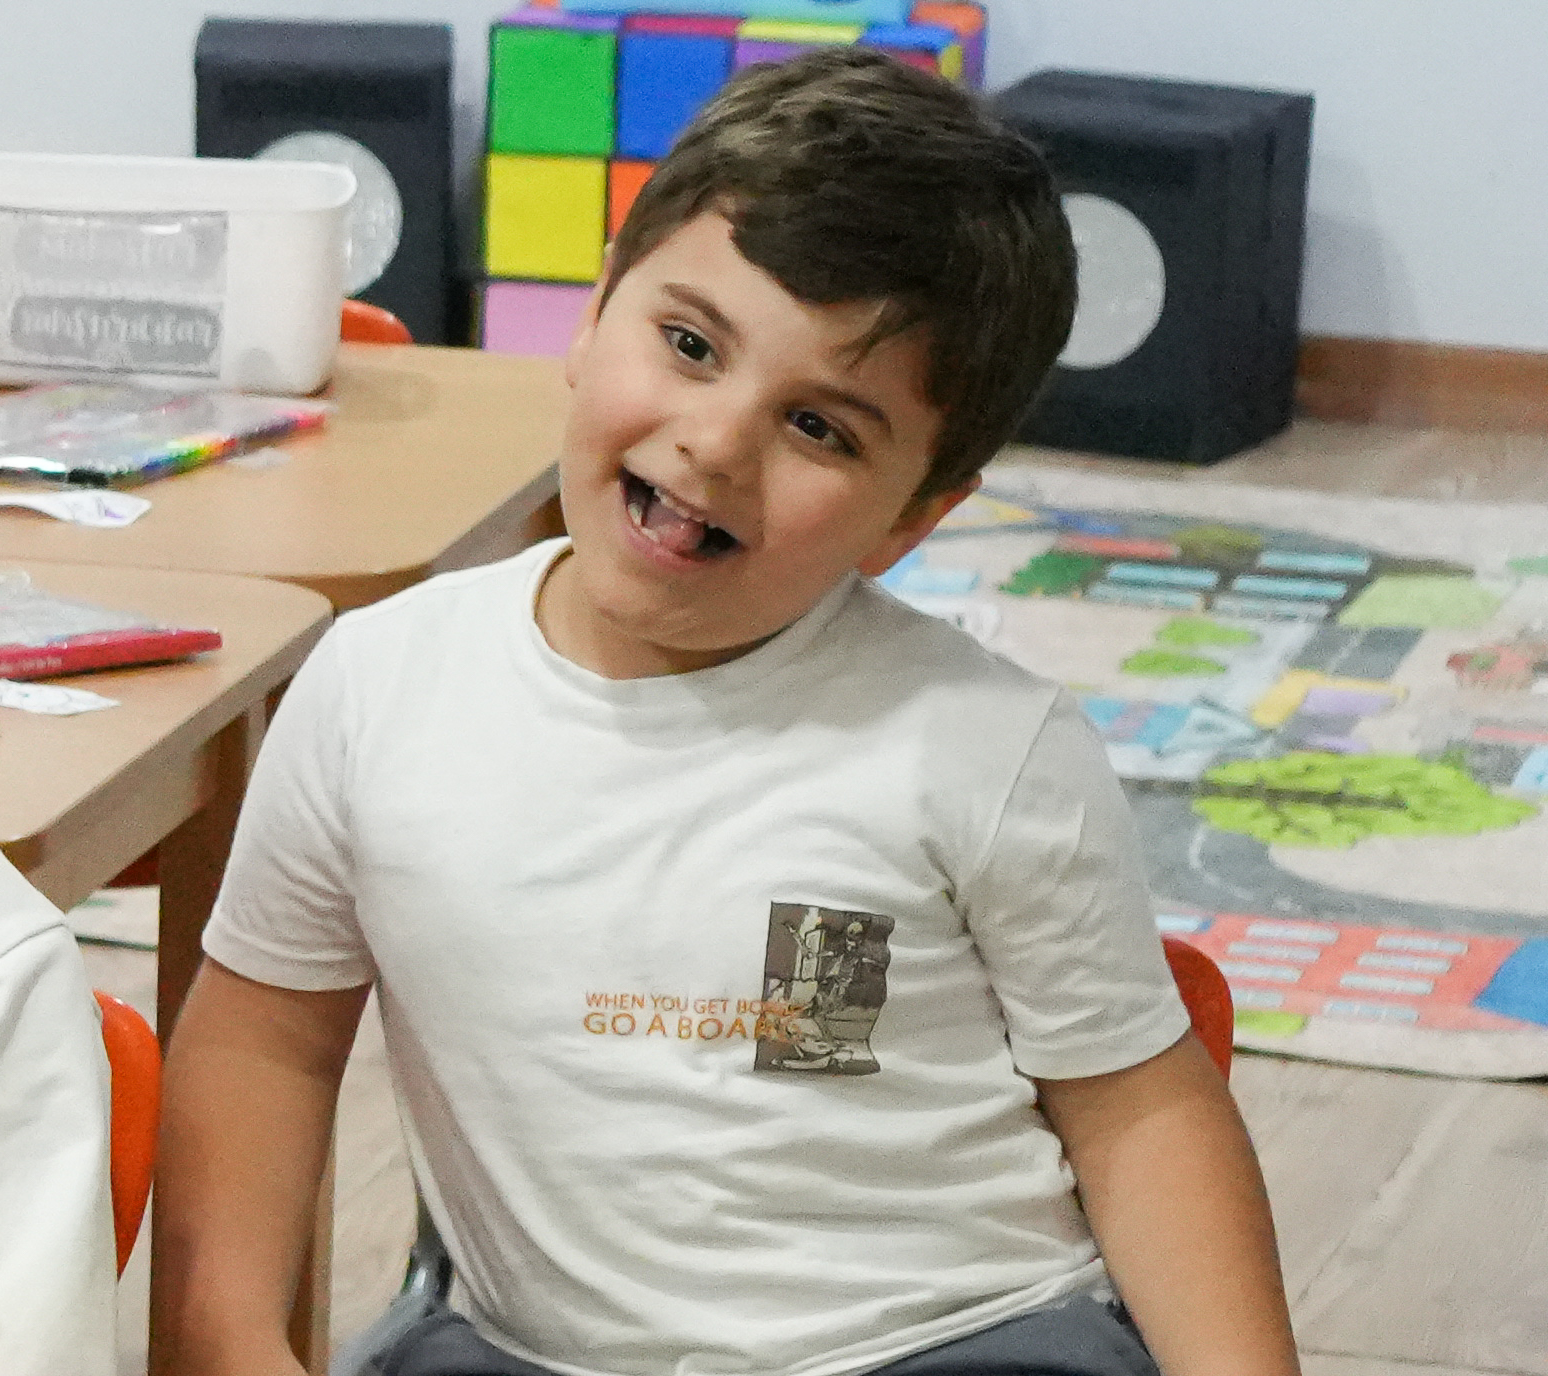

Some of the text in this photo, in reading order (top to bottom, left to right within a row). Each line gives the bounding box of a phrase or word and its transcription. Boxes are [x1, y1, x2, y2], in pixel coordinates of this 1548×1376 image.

[585, 991, 645, 1010] WHEN
[651, 994, 689, 1012] YOU
[693, 998, 730, 1014] GET
[583, 1012, 636, 1036] GO
[646, 1013, 667, 1038] A
